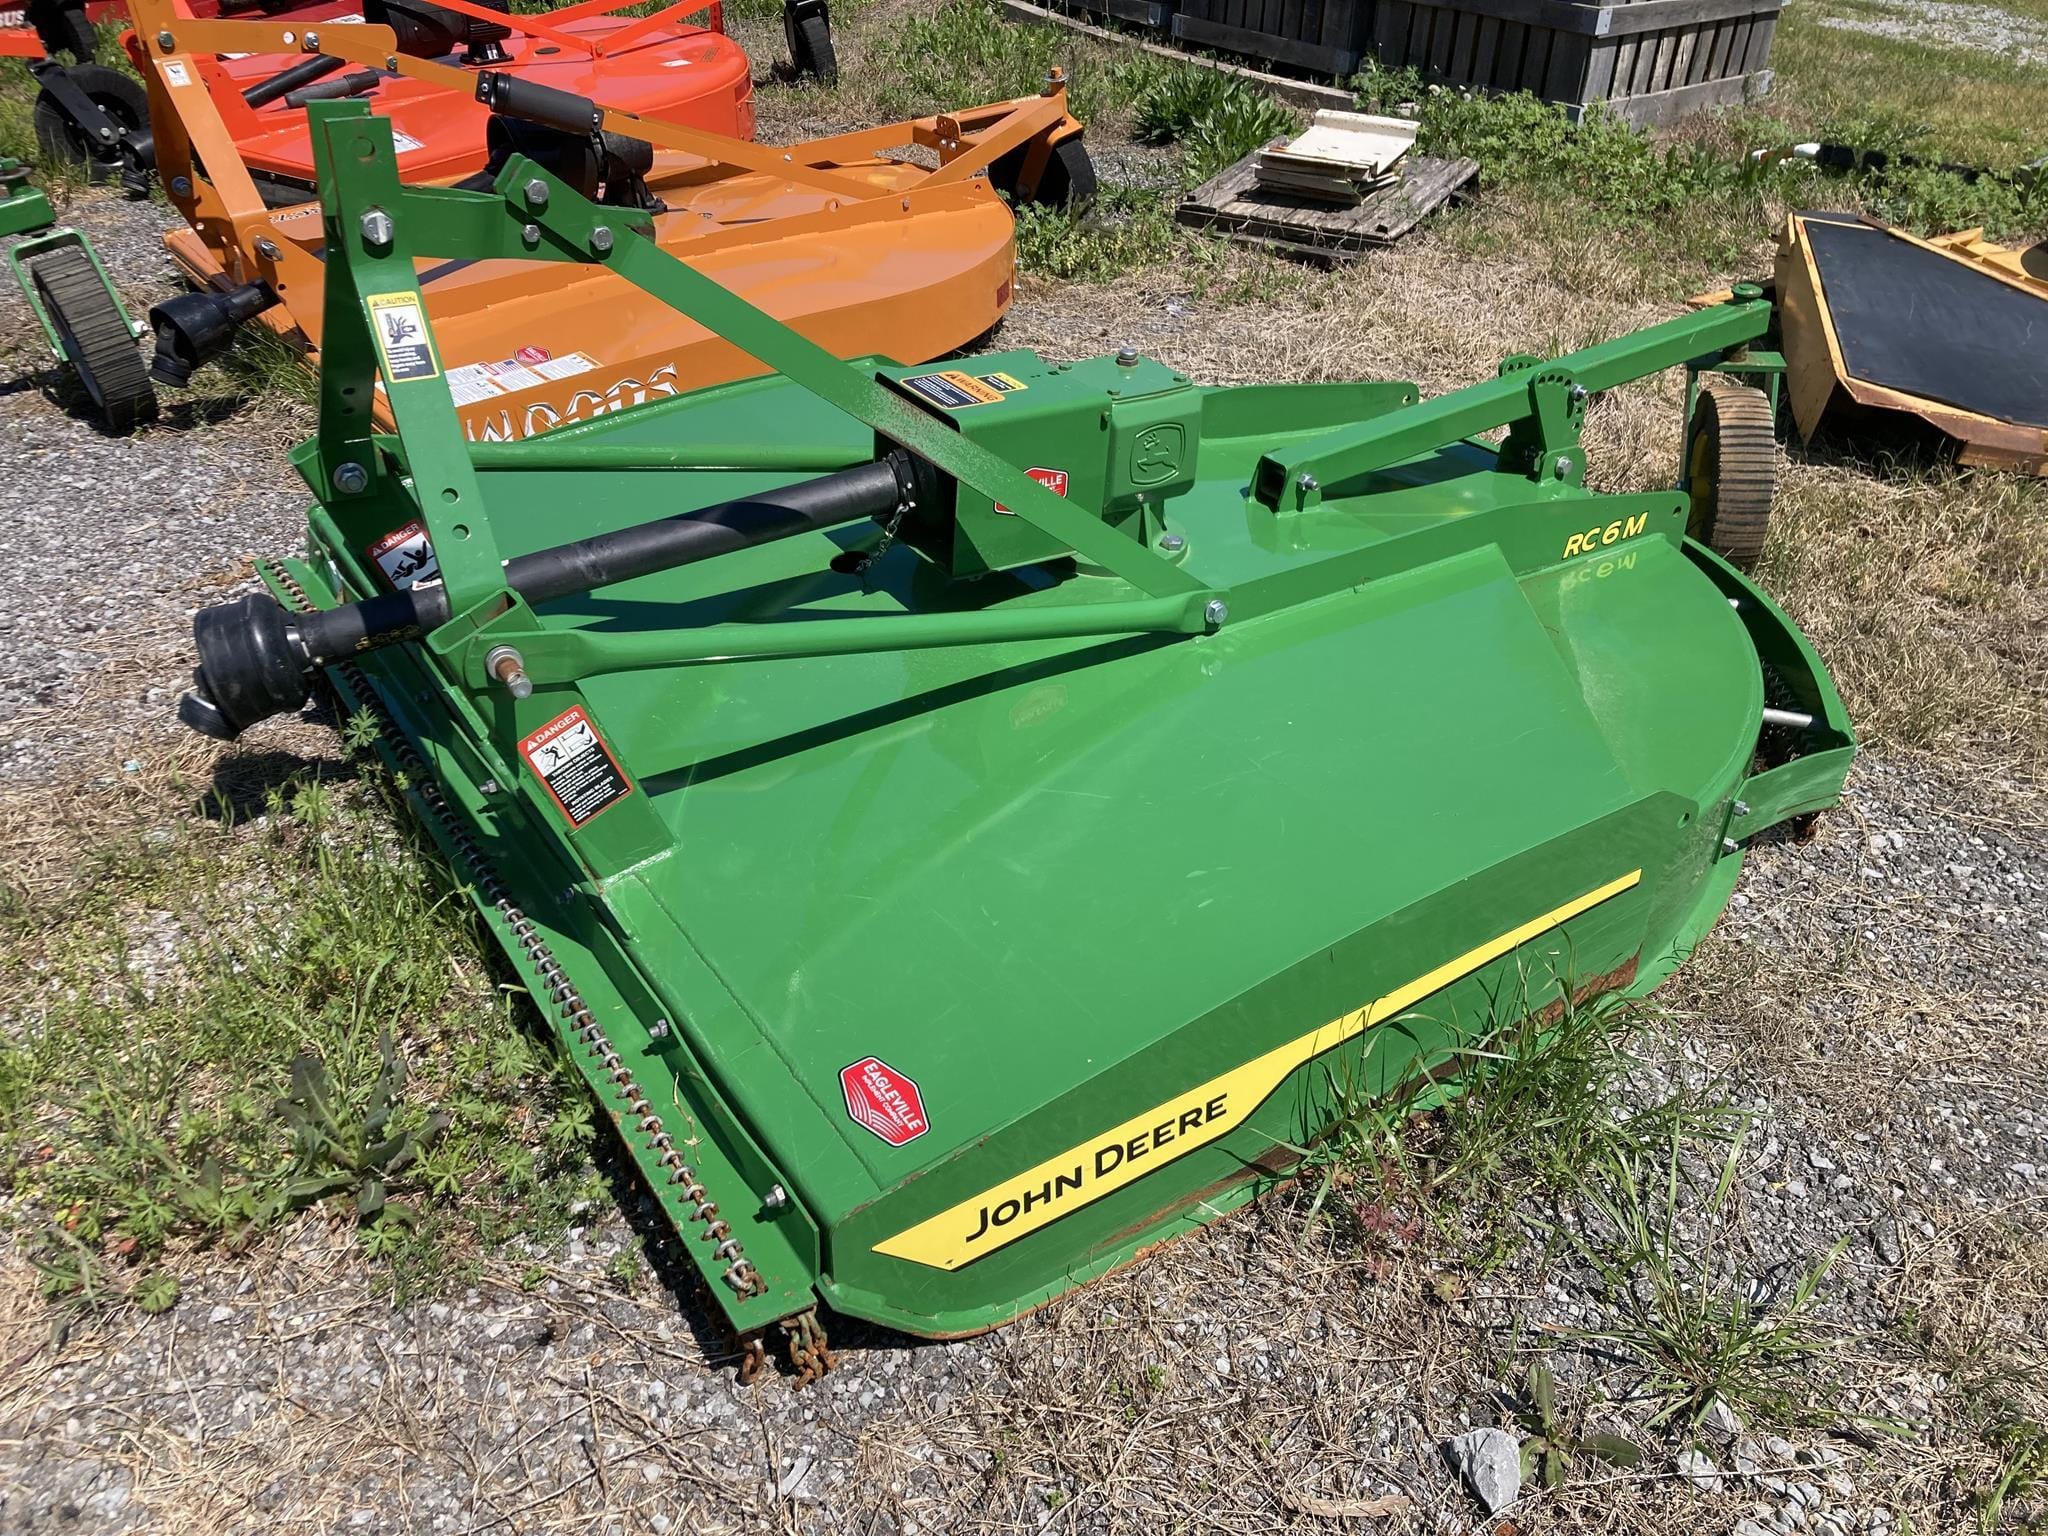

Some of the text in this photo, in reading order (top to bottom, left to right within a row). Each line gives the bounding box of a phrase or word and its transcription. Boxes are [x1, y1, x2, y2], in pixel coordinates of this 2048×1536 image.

[380, 295, 416, 306] CAUTION
[959, 378, 999, 401] WARNING
[381, 523, 420, 550] DANGER
[1562, 511, 1649, 560] RC6M
[536, 711, 580, 743] DANGER
[861, 1074, 905, 1127] IMPLEMENT COMPANY
[863, 1062, 923, 1131] EAGLEVILLE
[966, 1093, 1227, 1243] JOHN DEERE
